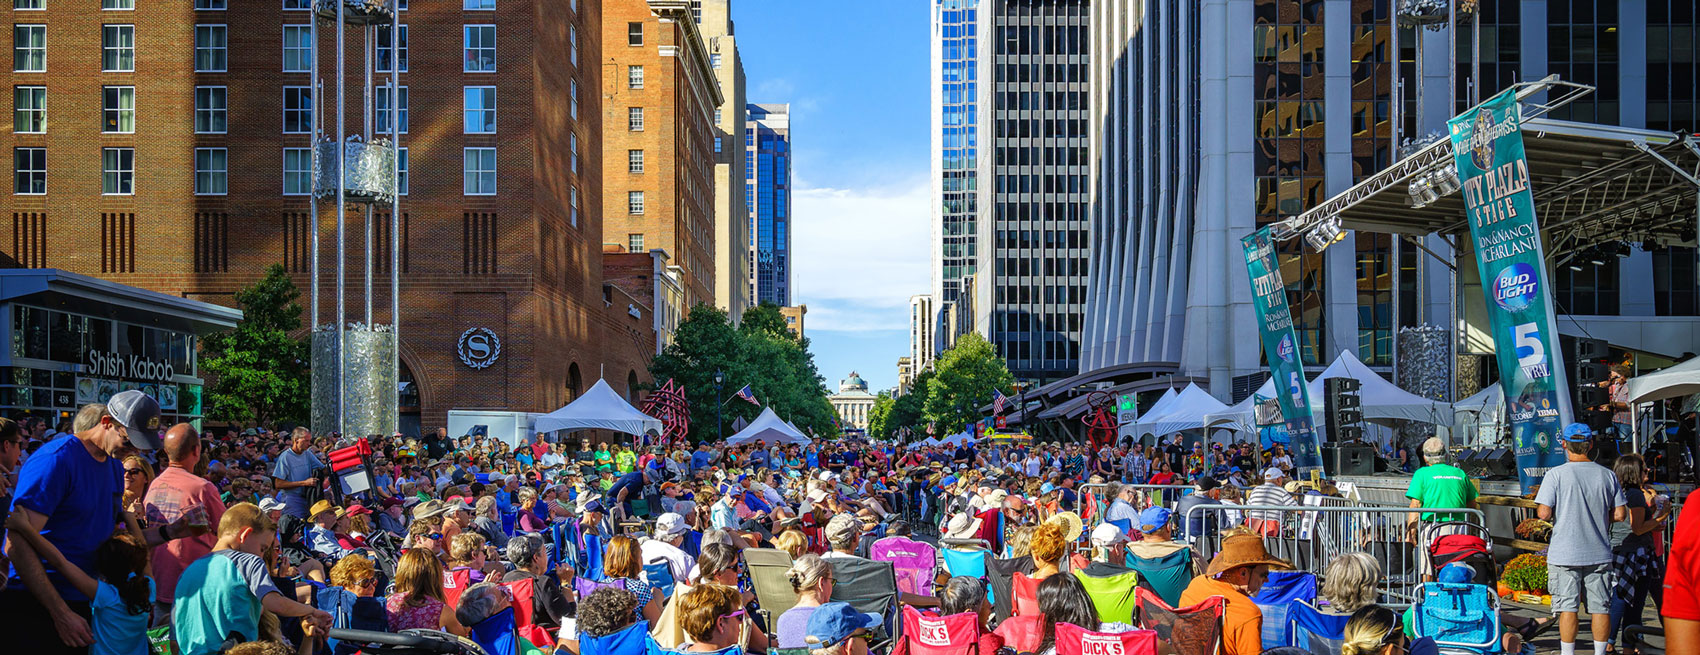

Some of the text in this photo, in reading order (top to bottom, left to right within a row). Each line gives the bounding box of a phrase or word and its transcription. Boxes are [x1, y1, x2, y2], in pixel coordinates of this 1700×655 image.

[1458, 119, 1471, 132] PNC
[1485, 159, 1528, 202] PLAZA
[1475, 197, 1518, 228] STAGE
[1497, 282, 1537, 300] LIGHT
[1500, 273, 1530, 289] BUD
[1515, 321, 1544, 368] 5
[88, 349, 174, 381] Shish Kabob
[1521, 363, 1551, 380] WRAL
[1290, 371, 1302, 400] 5
[59, 395, 69, 404] 438
